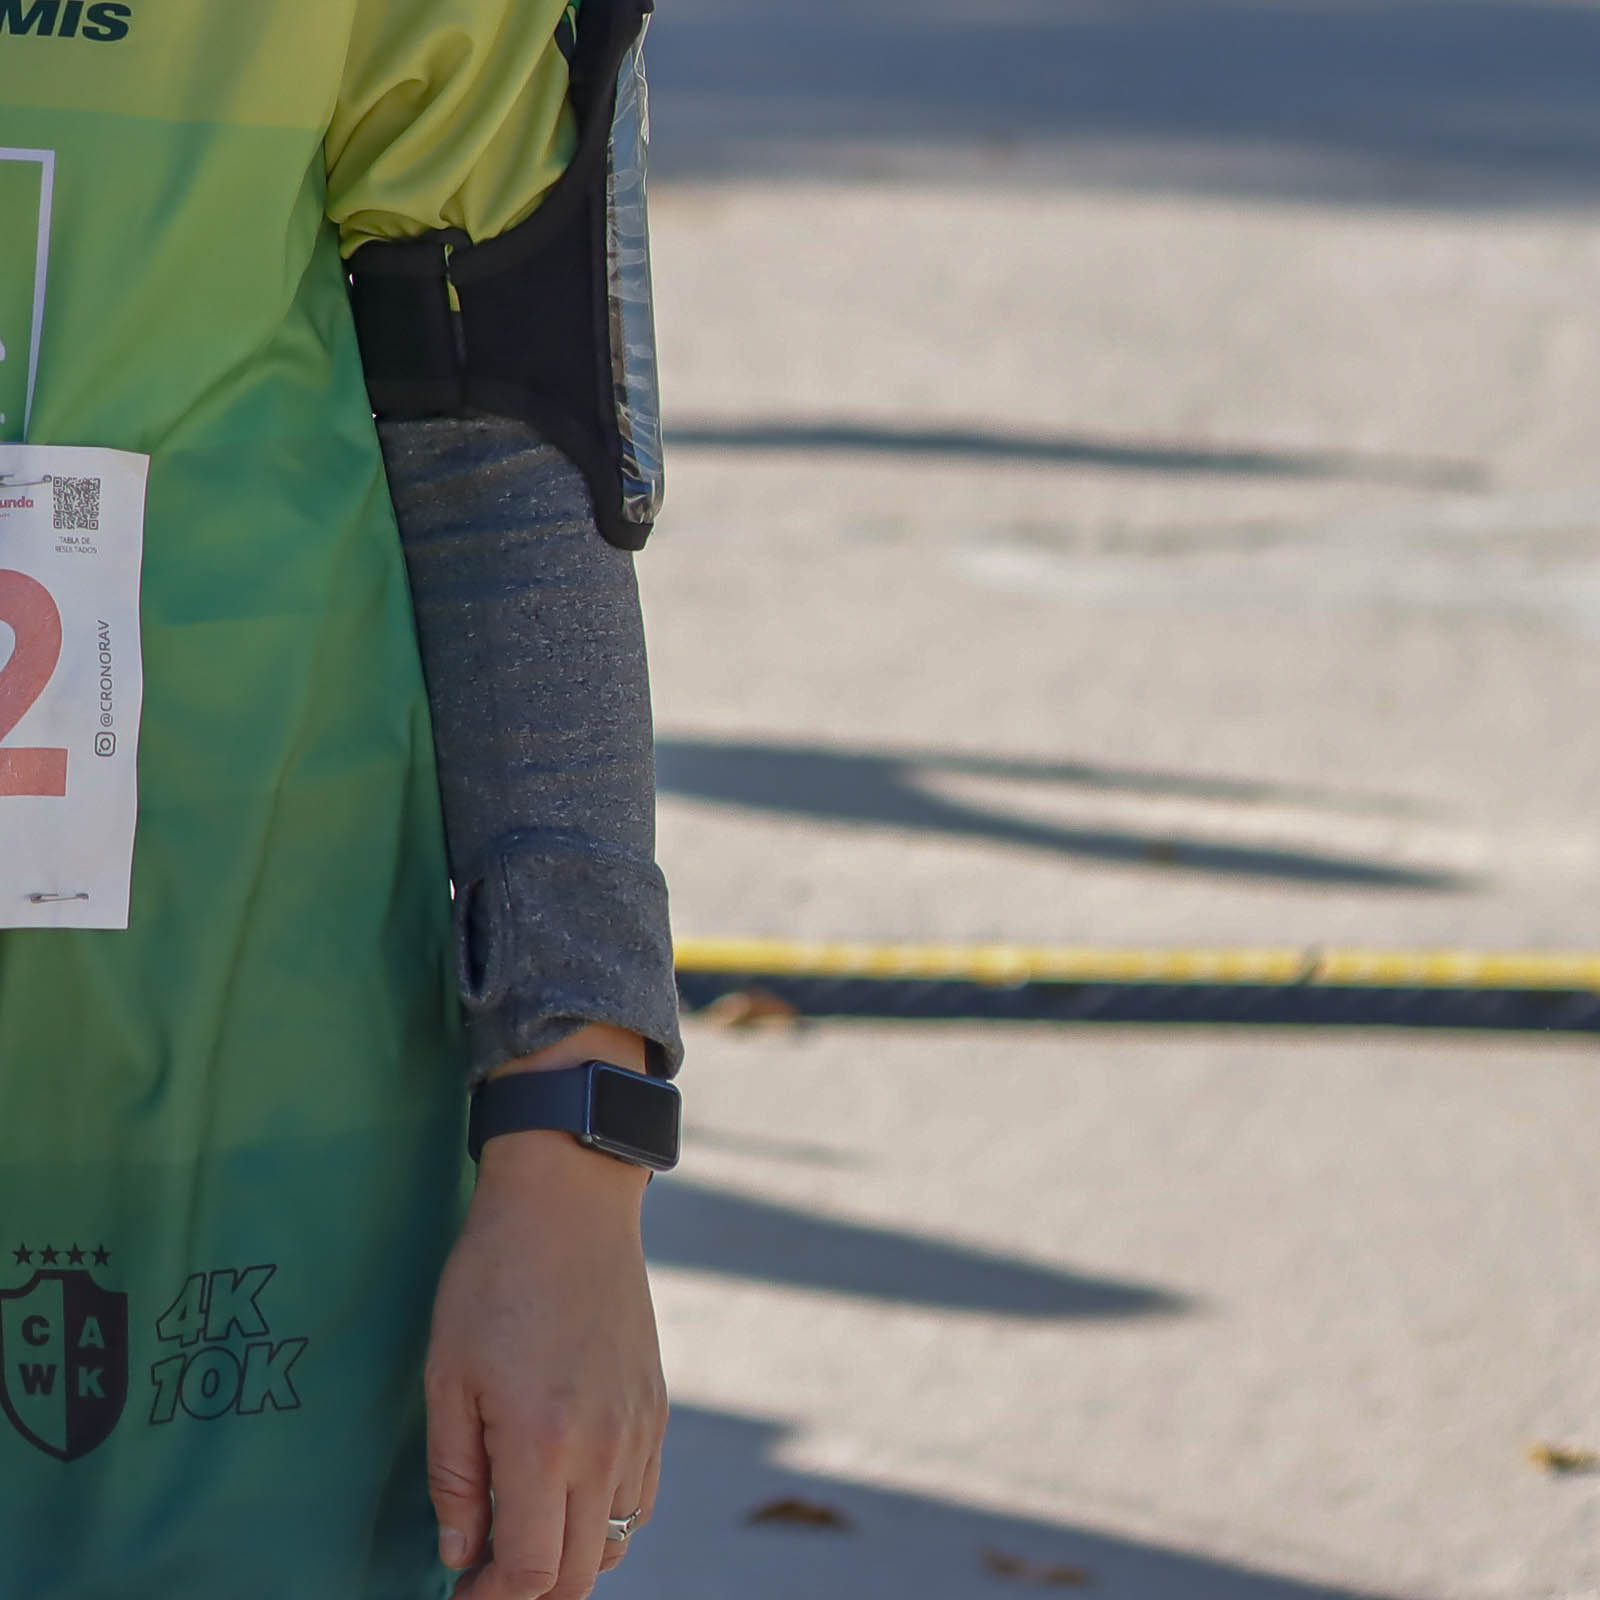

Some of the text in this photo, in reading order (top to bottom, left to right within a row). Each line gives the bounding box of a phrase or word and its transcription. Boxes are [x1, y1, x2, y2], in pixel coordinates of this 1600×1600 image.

[97, 619, 114, 728] @CRONORAV
[156, 1264, 277, 1348] 4K
[149, 1337, 309, 1426] 10K
